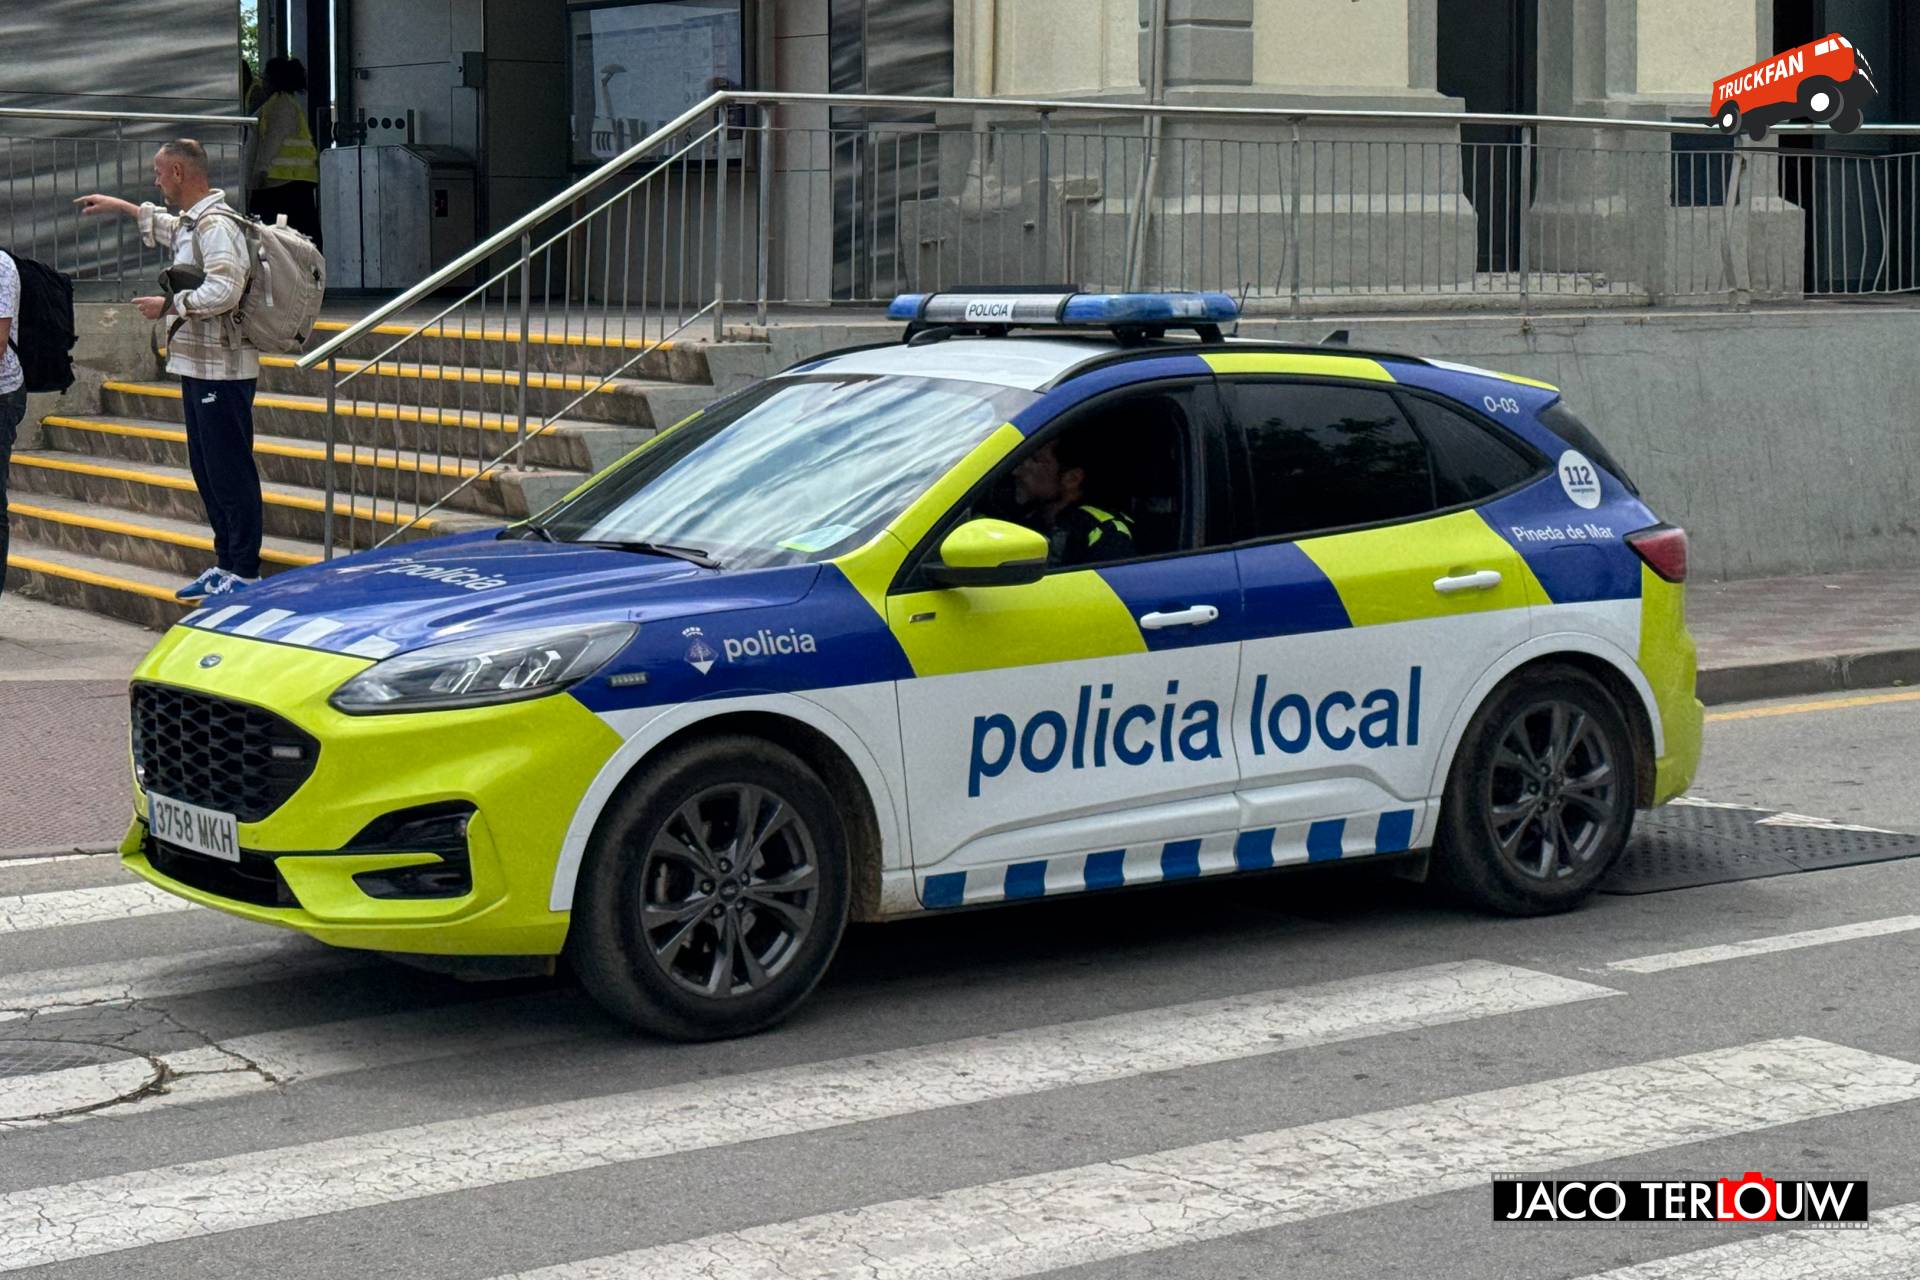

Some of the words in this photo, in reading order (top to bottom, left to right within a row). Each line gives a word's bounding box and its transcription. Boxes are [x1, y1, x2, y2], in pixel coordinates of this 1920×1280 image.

[968, 303, 1009, 317] POLICIA
[1483, 395, 1521, 415] O-03
[1564, 465, 1594, 486] 112
[1511, 523, 1565, 542] Pineda
[1566, 524, 1584, 539] de
[1584, 523, 1616, 539] Mar
[375, 563, 508, 591] policia
[723, 627, 817, 663] policia
[967, 679, 1222, 798] policia
[1250, 665, 1422, 756] local
[156, 801, 194, 843] 3758
[197, 812, 233, 855] MKH
